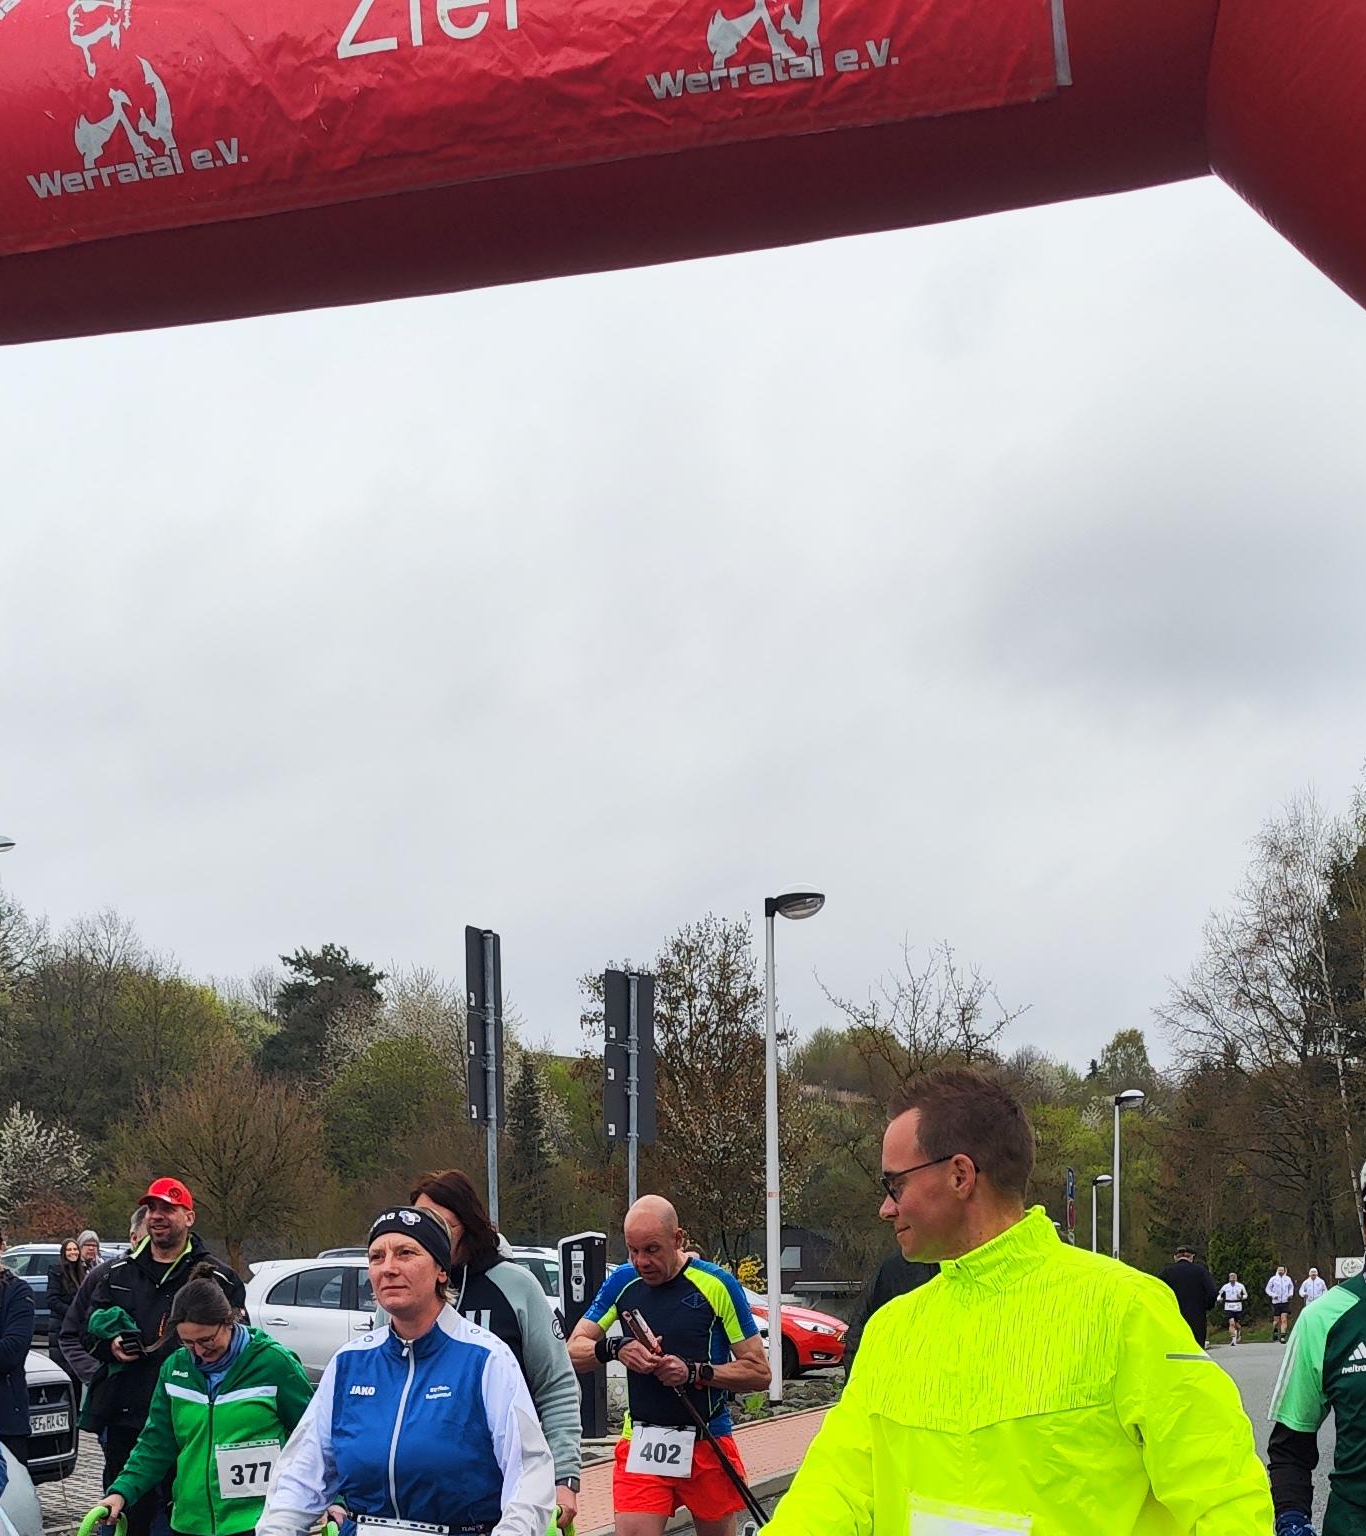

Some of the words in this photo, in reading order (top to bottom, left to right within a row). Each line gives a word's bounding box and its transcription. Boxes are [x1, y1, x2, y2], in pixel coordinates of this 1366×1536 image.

[645, 47, 825, 100] Werratal
[835, 38, 900, 73] e.V.
[27, 147, 185, 199] Werratal
[190, 137, 249, 171] e.V.
[350, 1385, 375, 1396] JAKO
[640, 1442, 681, 1464] 402
[230, 1461, 271, 1485] 377
